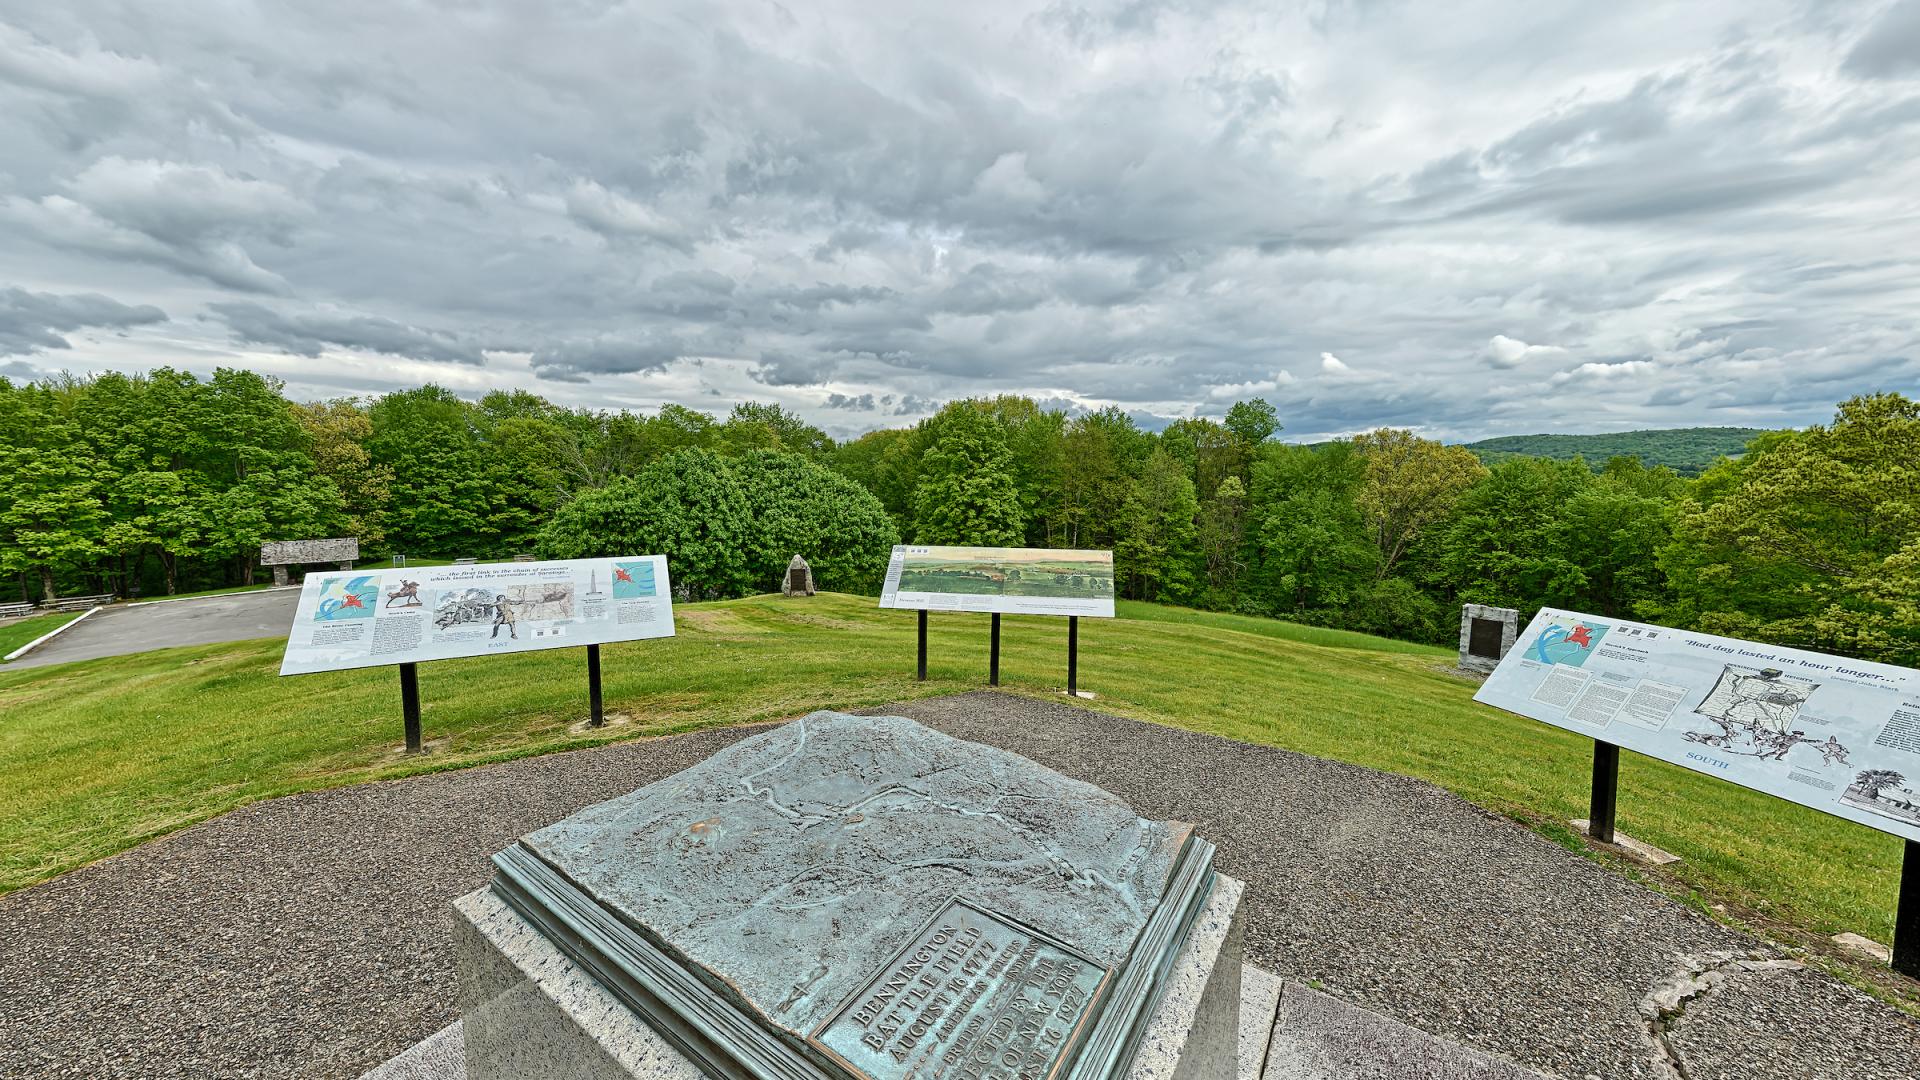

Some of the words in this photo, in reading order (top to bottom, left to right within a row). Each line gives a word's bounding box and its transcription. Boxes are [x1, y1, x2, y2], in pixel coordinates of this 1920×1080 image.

[1715, 644, 1735, 654] day
[1740, 648, 1776, 661] lasted
[1779, 656, 1795, 665] an
[1800, 659, 1832, 671] hour
[1685, 751, 1729, 769] SOUTH
[852, 924, 957, 1027] BENNINGTON
[864, 973, 939, 1051] BATTLE
[935, 926, 982, 975] FIELD
[889, 993, 952, 1063] AUGUST
[949, 976, 967, 996] 16
[962, 940, 997, 978] 1777
[935, 981, 988, 1043] AMERICAN
[987, 940, 1021, 979] FORCES
[944, 1015, 986, 1065] BRITISH
[1006, 939, 1039, 980] INDIANS
[957, 1016, 1016, 1080] ECTED
[1011, 993, 1031, 1014] BY
[1027, 959, 1056, 990] THE
[1002, 1041, 1026, 1068] OF
[1019, 998, 1053, 1042] NEW
[1045, 960, 1081, 998] YORK
[1043, 1027, 1063, 1048] 16
[1056, 984, 1087, 1024] 1927
